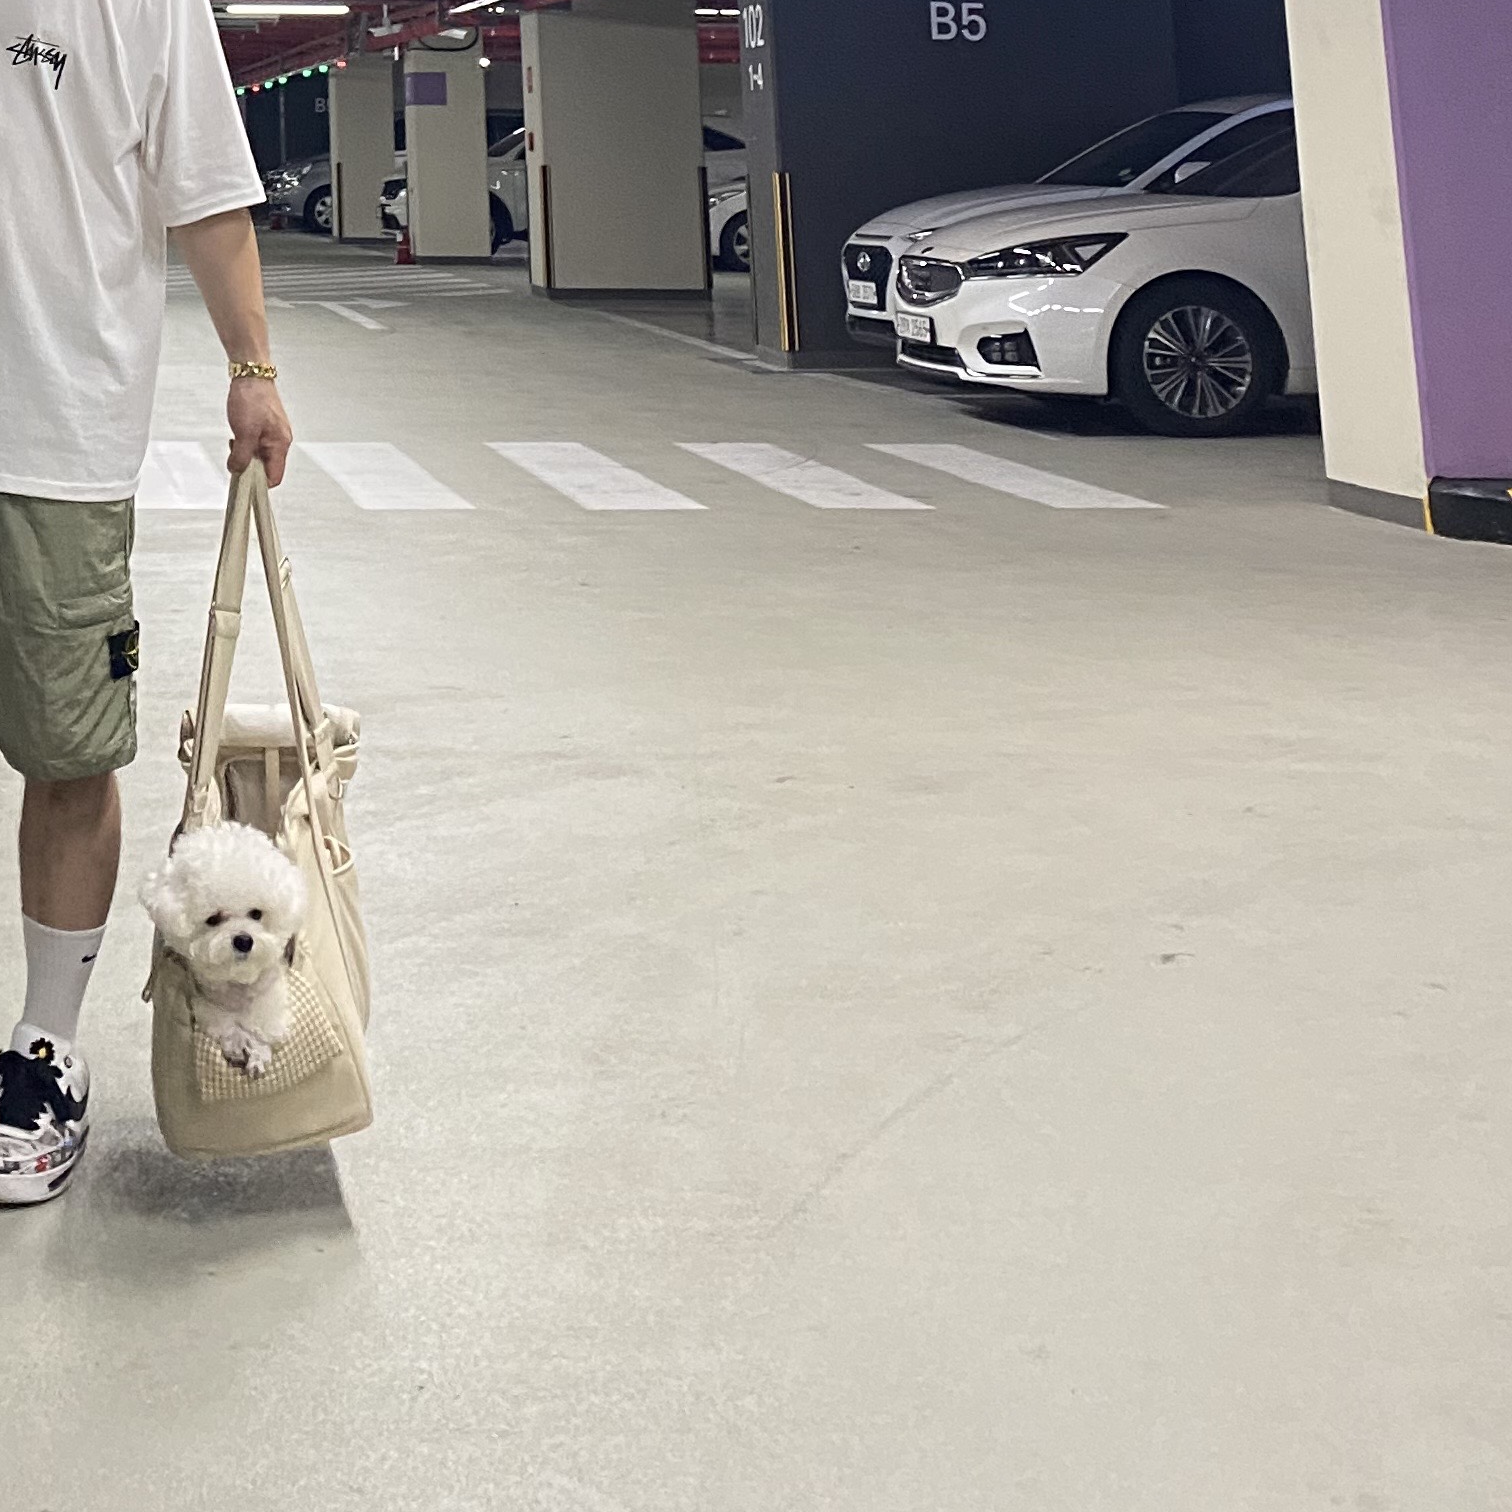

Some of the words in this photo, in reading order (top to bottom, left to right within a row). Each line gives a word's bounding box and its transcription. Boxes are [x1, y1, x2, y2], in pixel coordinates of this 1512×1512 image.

[742, 4, 765, 48] 102
[930, 1, 987, 41] B5
[315, 97, 329, 113] B
